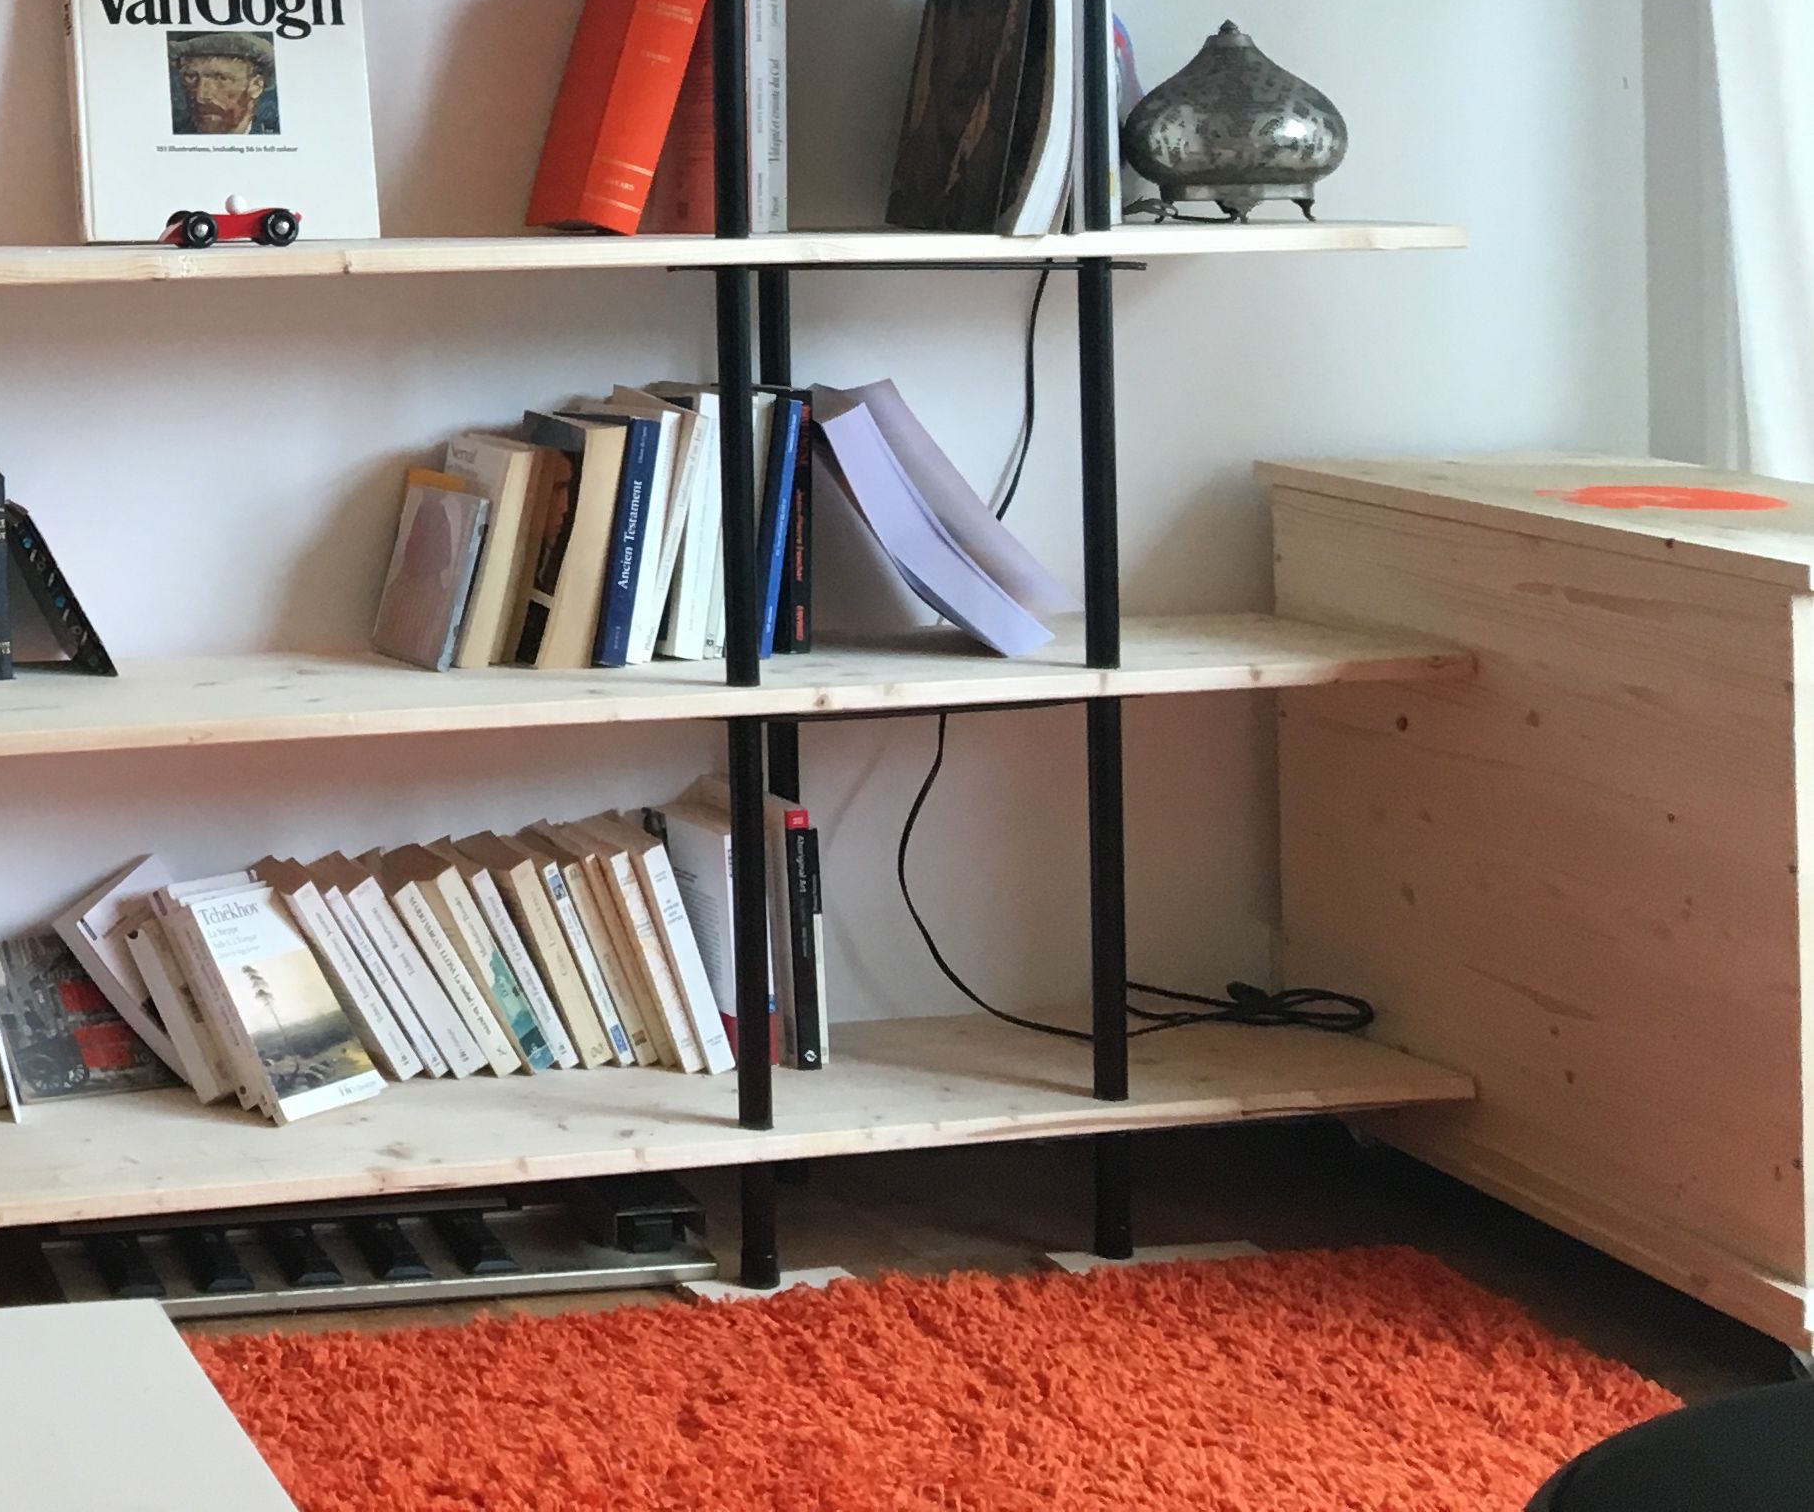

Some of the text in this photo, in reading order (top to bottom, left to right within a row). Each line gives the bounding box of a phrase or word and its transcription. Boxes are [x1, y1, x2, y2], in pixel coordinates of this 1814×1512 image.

[769, 76, 779, 88] du
[617, 478, 644, 590] Ancien Testament
[799, 879, 807, 894] Art
